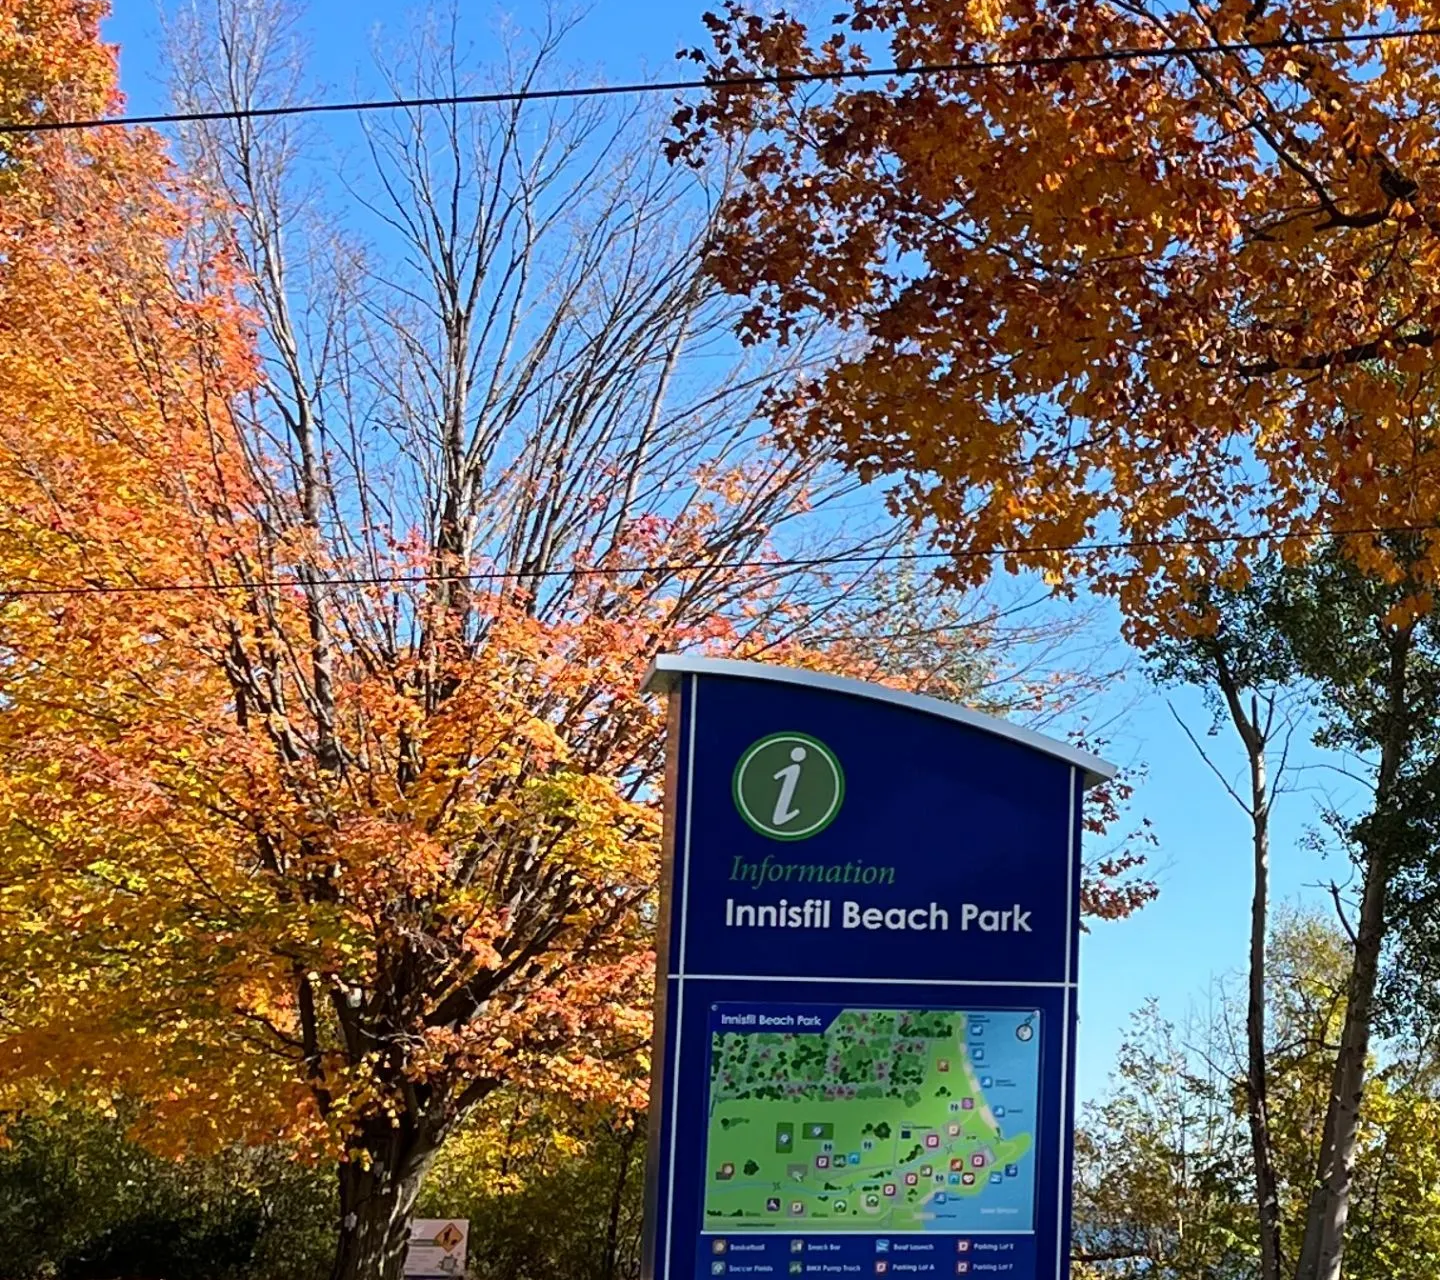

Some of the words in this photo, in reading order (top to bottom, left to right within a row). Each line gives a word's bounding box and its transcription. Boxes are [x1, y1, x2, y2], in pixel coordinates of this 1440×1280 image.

[727, 854, 896, 889] Information
[725, 897, 831, 928] Innisfil
[842, 900, 949, 931] Beach
[961, 903, 1033, 933] Park
[721, 1014, 756, 1025] Innisfil
[759, 1015, 794, 1026] Beach
[797, 1015, 822, 1026] Park
